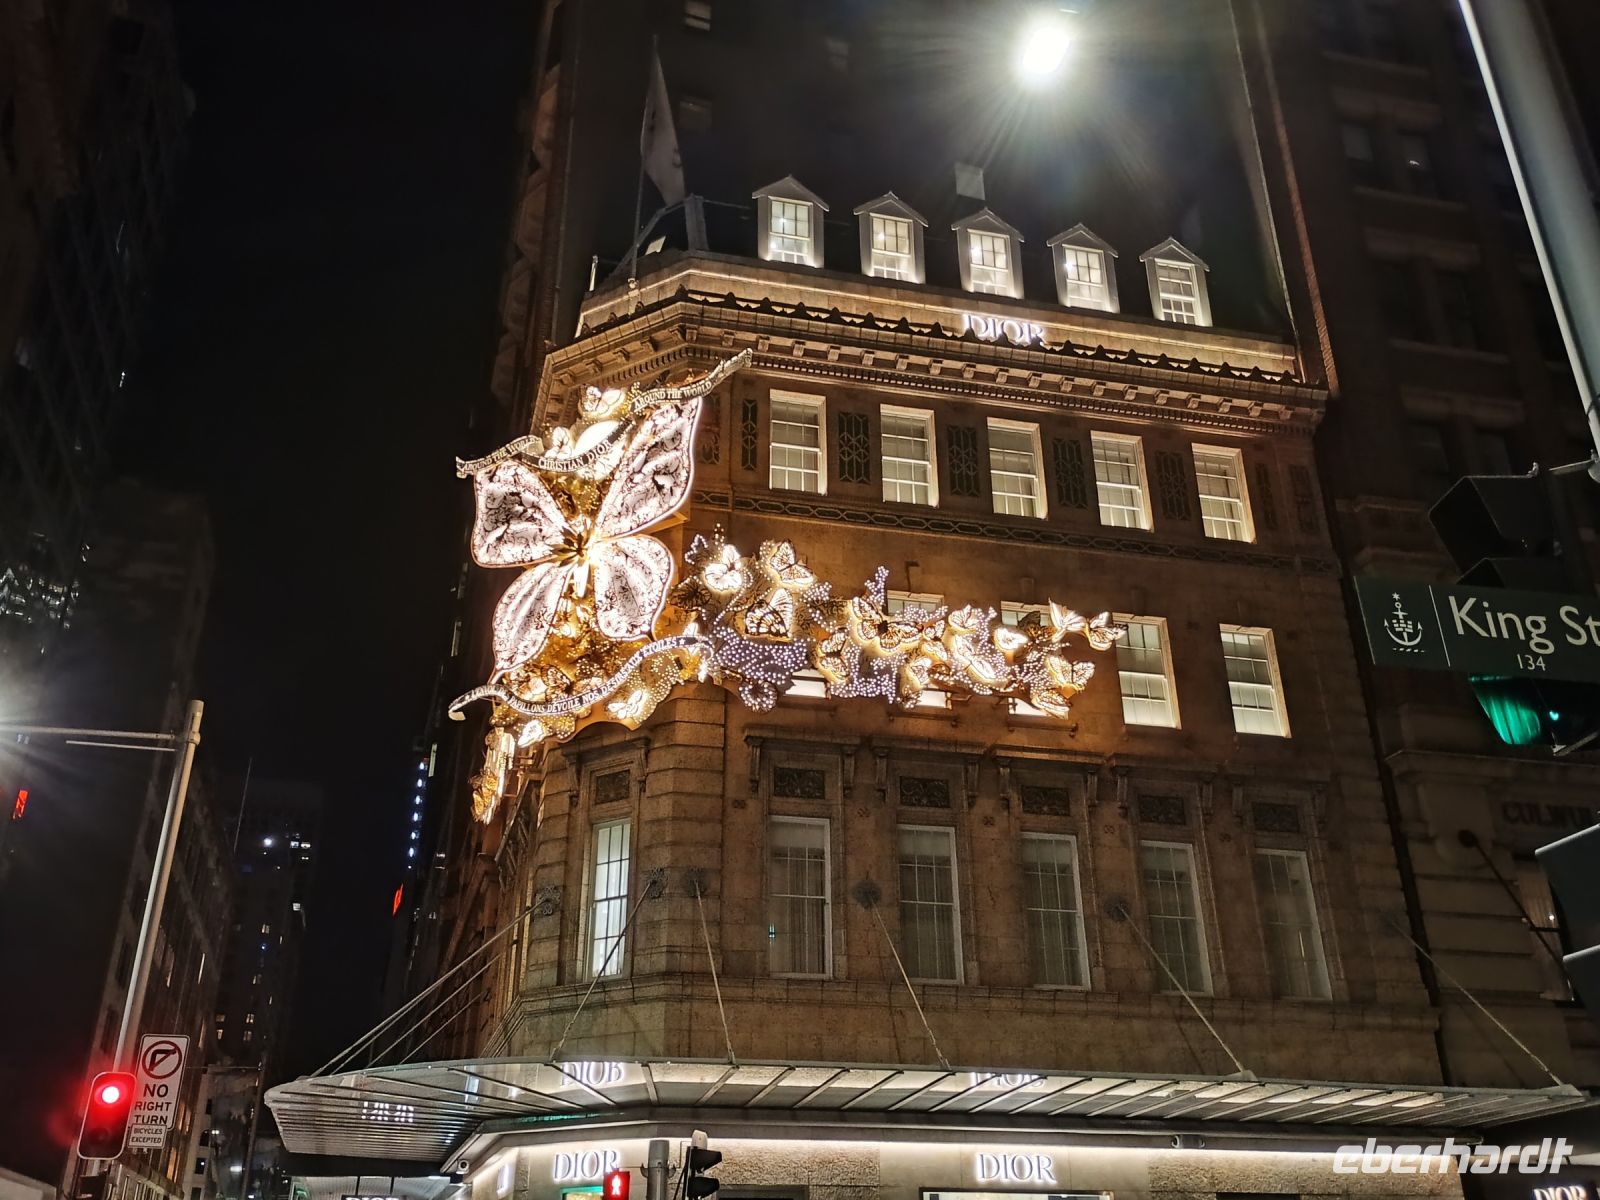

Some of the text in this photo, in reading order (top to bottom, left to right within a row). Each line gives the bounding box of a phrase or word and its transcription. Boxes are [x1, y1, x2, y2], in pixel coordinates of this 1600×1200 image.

[962, 313, 1046, 346] DIOR
[634, 381, 712, 409] AROUND THE WORLD
[492, 449, 507, 462] THE
[539, 440, 613, 471] CHRISTIAN DIOR
[1449, 595, 1600, 655] King St
[1516, 653, 1546, 671] 134
[509, 695, 545, 713] PAPILLONS
[582, 691, 600, 704] NOS
[143, 1083, 169, 1098] NO
[134, 1101, 172, 1112] RIGHT
[134, 1114, 168, 1125] TURN
[131, 1136, 162, 1144] EXCEPTED
[554, 1150, 619, 1180] DIOR
[976, 1153, 1057, 1183] DIOR
[1533, 1185, 1588, 1200] DIOR
